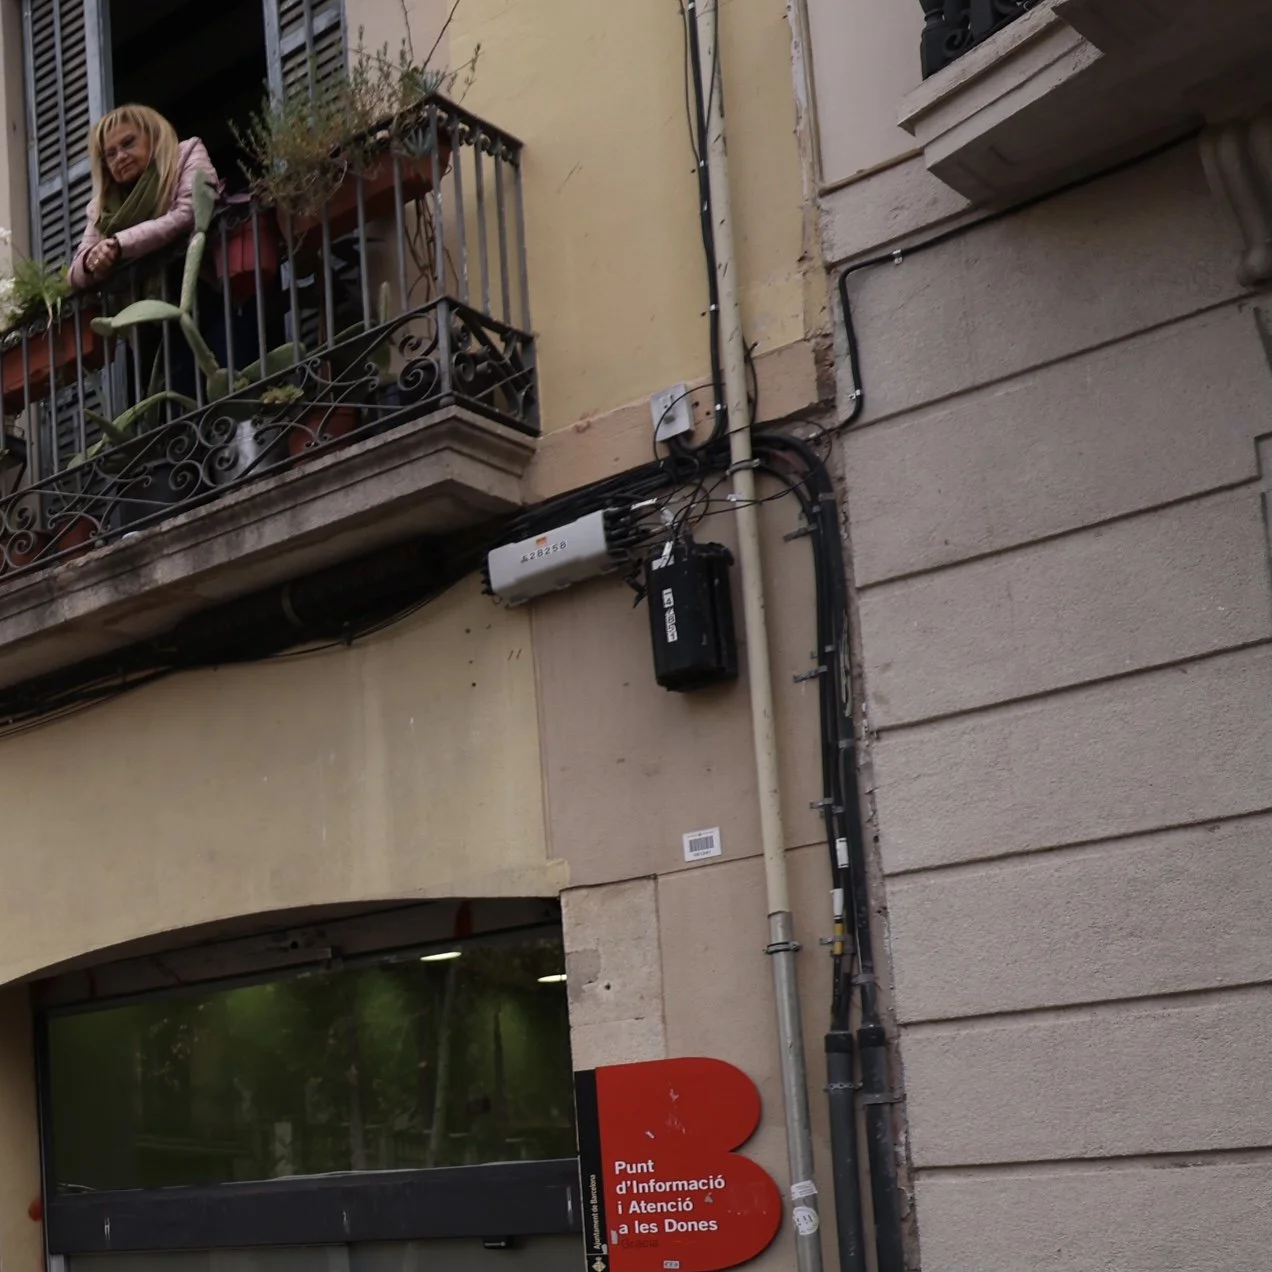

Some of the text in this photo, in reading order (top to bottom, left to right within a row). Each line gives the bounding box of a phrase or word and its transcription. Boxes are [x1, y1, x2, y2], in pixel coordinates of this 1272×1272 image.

[615, 1160, 655, 1175] Punt
[616, 1174, 726, 1194] d'Informació
[590, 1174, 602, 1250] Ajuntament de Barcelona
[617, 1197, 694, 1214] i Atenció
[619, 1218, 718, 1235] a les Dones
